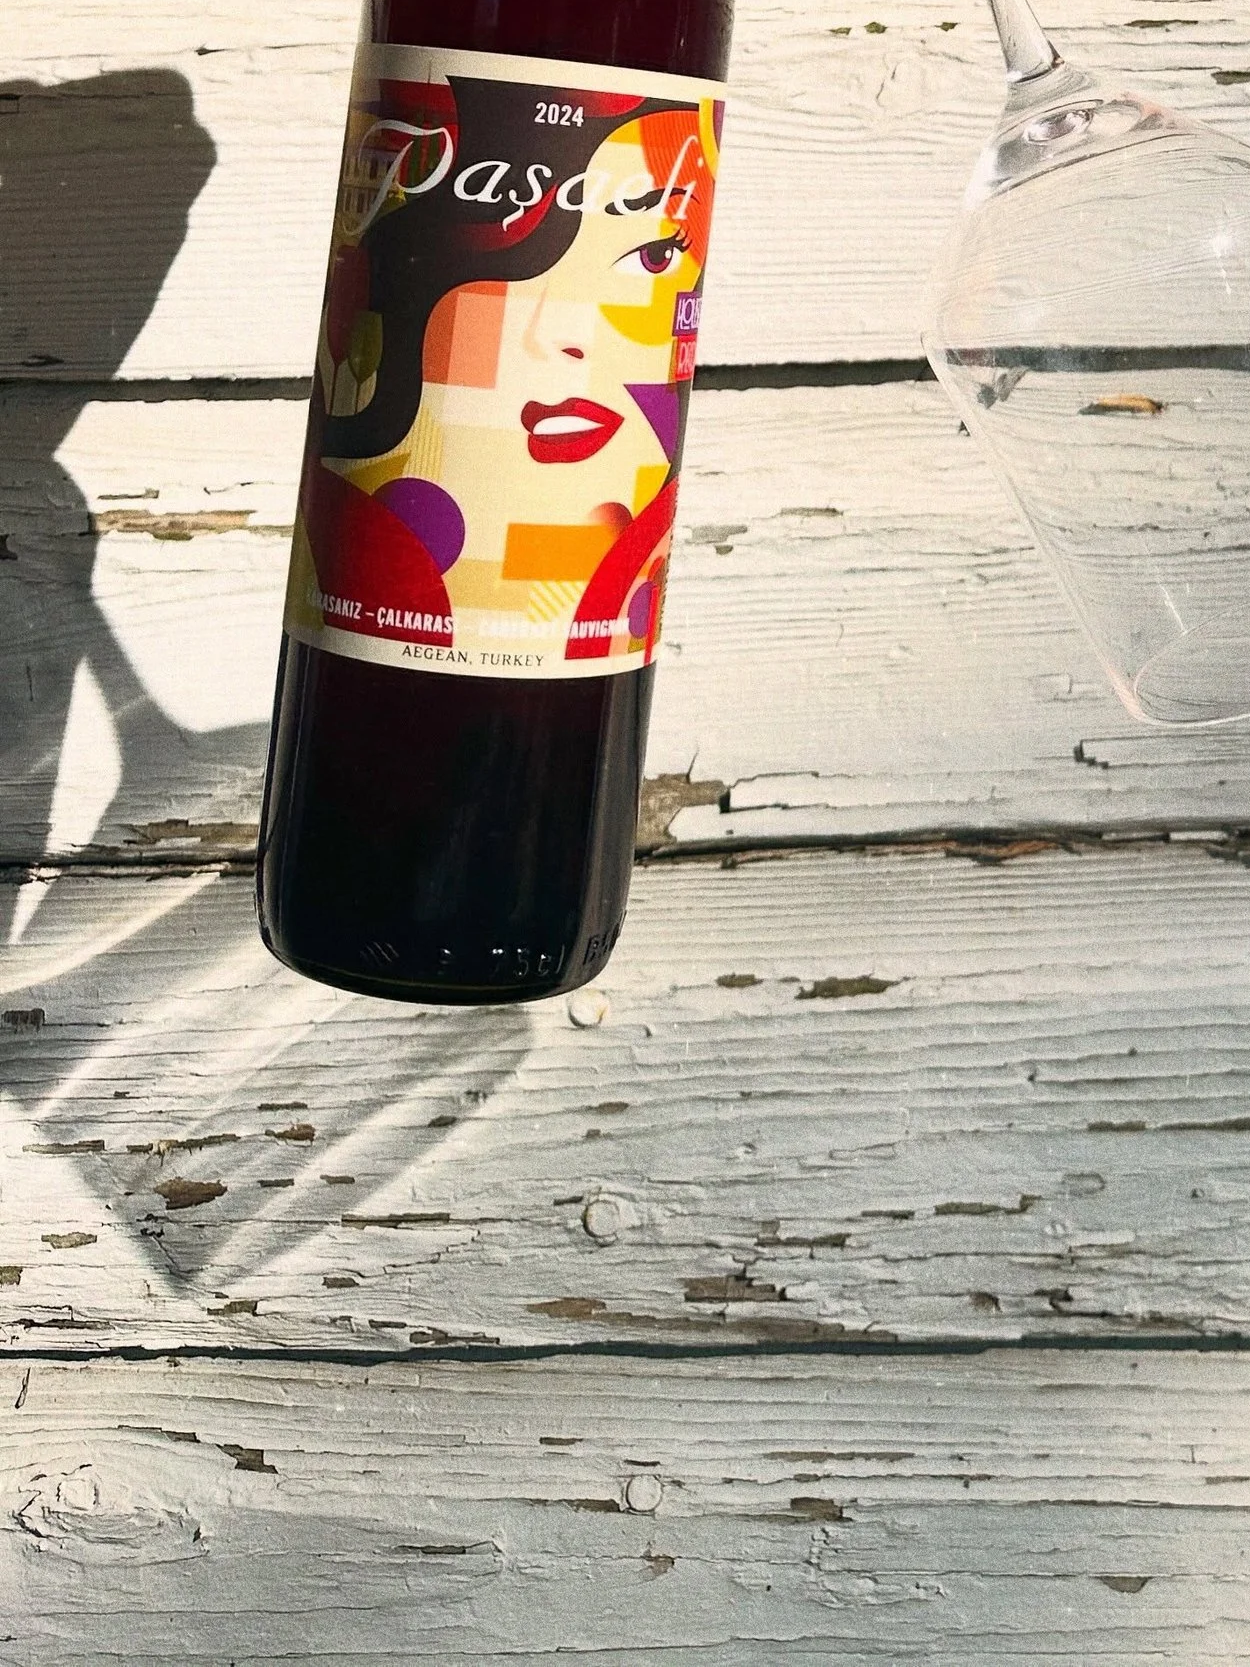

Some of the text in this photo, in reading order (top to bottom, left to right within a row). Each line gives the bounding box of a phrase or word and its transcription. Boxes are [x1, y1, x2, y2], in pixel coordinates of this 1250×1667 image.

[534, 101, 584, 127] 2024
[402, 644, 545, 667] AEGEAN, TURKEY
